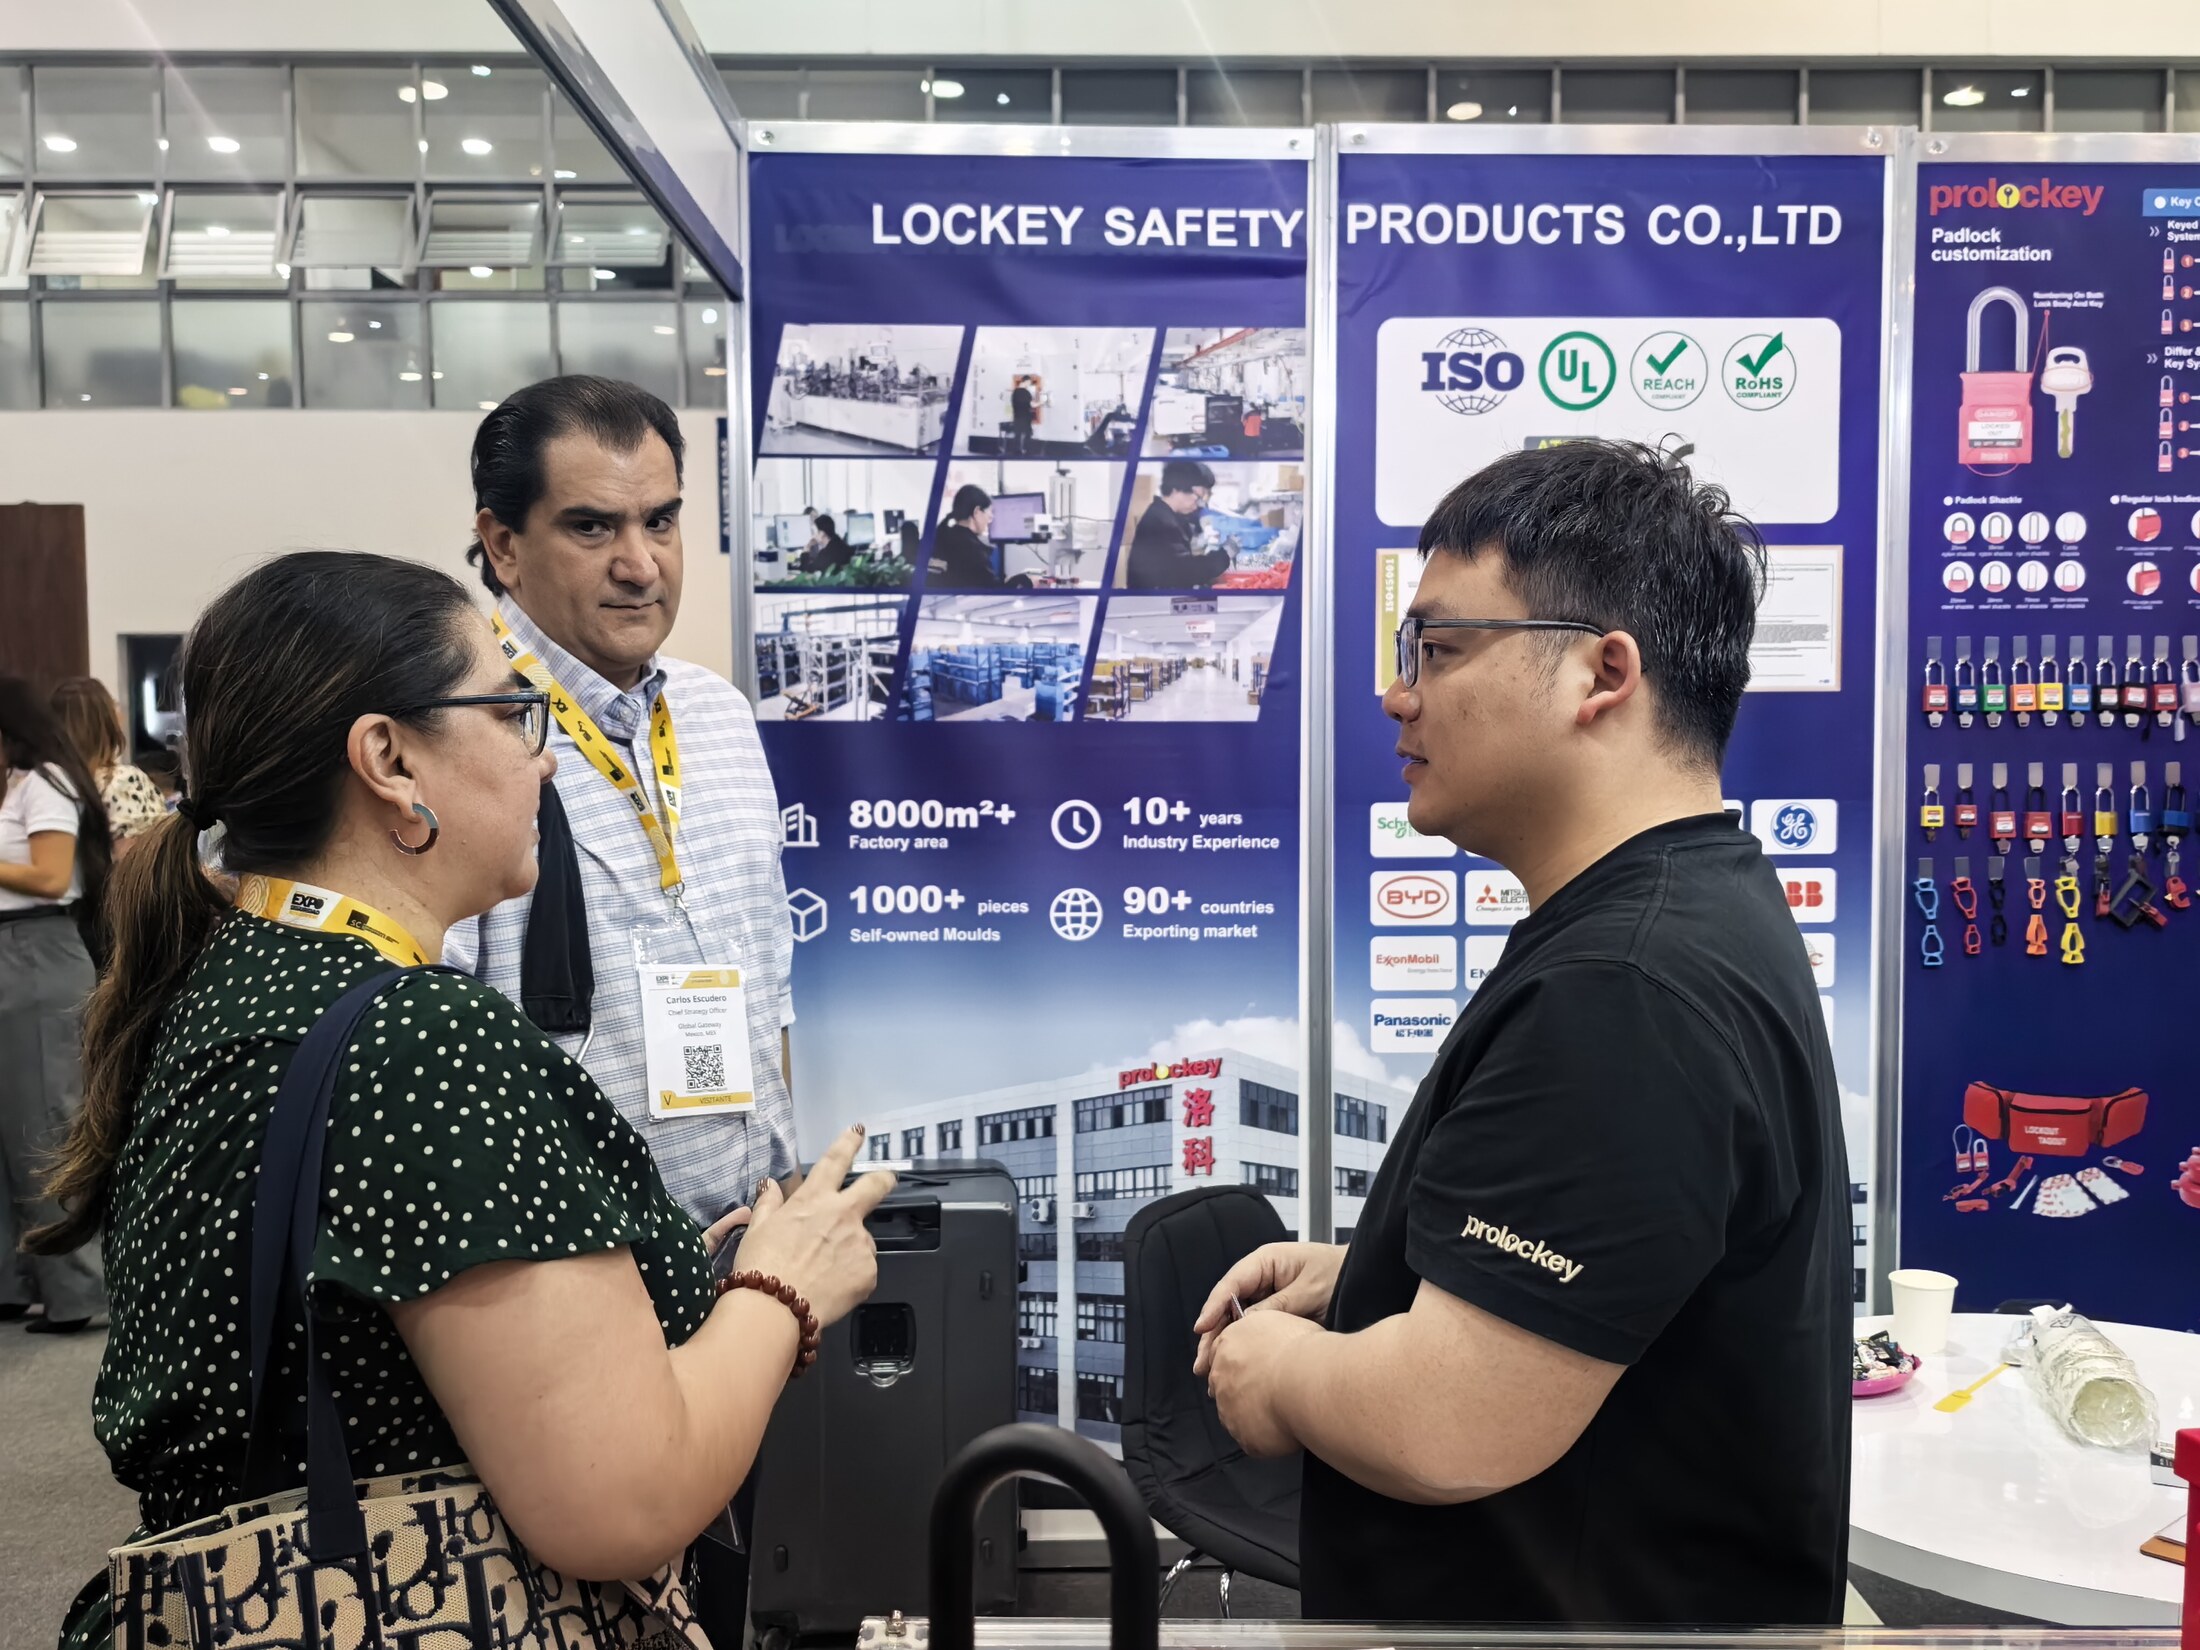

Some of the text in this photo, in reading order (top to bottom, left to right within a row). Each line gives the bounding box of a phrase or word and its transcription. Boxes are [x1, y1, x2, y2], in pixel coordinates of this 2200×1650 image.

[1929, 178, 2104, 216] prolockey
[2170, 196, 2192, 209] Key
[872, 203, 1842, 252] LOCKEY SAFETY PRODUCTS CO.,LTD
[2167, 220, 2199, 231] Keyed
[1931, 227, 2001, 243] Padlock
[1931, 245, 2052, 262] customization
[2164, 346, 2192, 356] Differ
[1421, 352, 1525, 392] ISO
[1558, 349, 1598, 394] UL
[2164, 359, 2184, 370] Key
[1643, 378, 1695, 391] REACH
[1735, 377, 1783, 390] RoHS
[1736, 391, 1783, 399] COMPLIANT
[1123, 797, 1243, 828] 10+ years
[850, 835, 949, 852] Factory area
[1123, 834, 1280, 852] Industry Experience
[291, 892, 325, 910] EXPO
[850, 885, 1029, 916] 1000+ pieces
[1123, 886, 1275, 914] 90+ countries
[1386, 889, 1441, 905] BYD
[1786, 881, 1824, 907] BB
[850, 928, 1001, 942] Self-owned Moulds
[1123, 924, 1258, 941] Exporting market
[1376, 954, 1439, 967] ExxonMobil
[666, 994, 727, 1004] Carlos Escudero
[1374, 1013, 1451, 1026] Panasonic
[1118, 1057, 1223, 1090] prolockey
[663, 1094, 732, 1106] V VISITANTE
[1182, 1087, 1216, 1177] 洛科
[1460, 1214, 1585, 1283] prolockey
